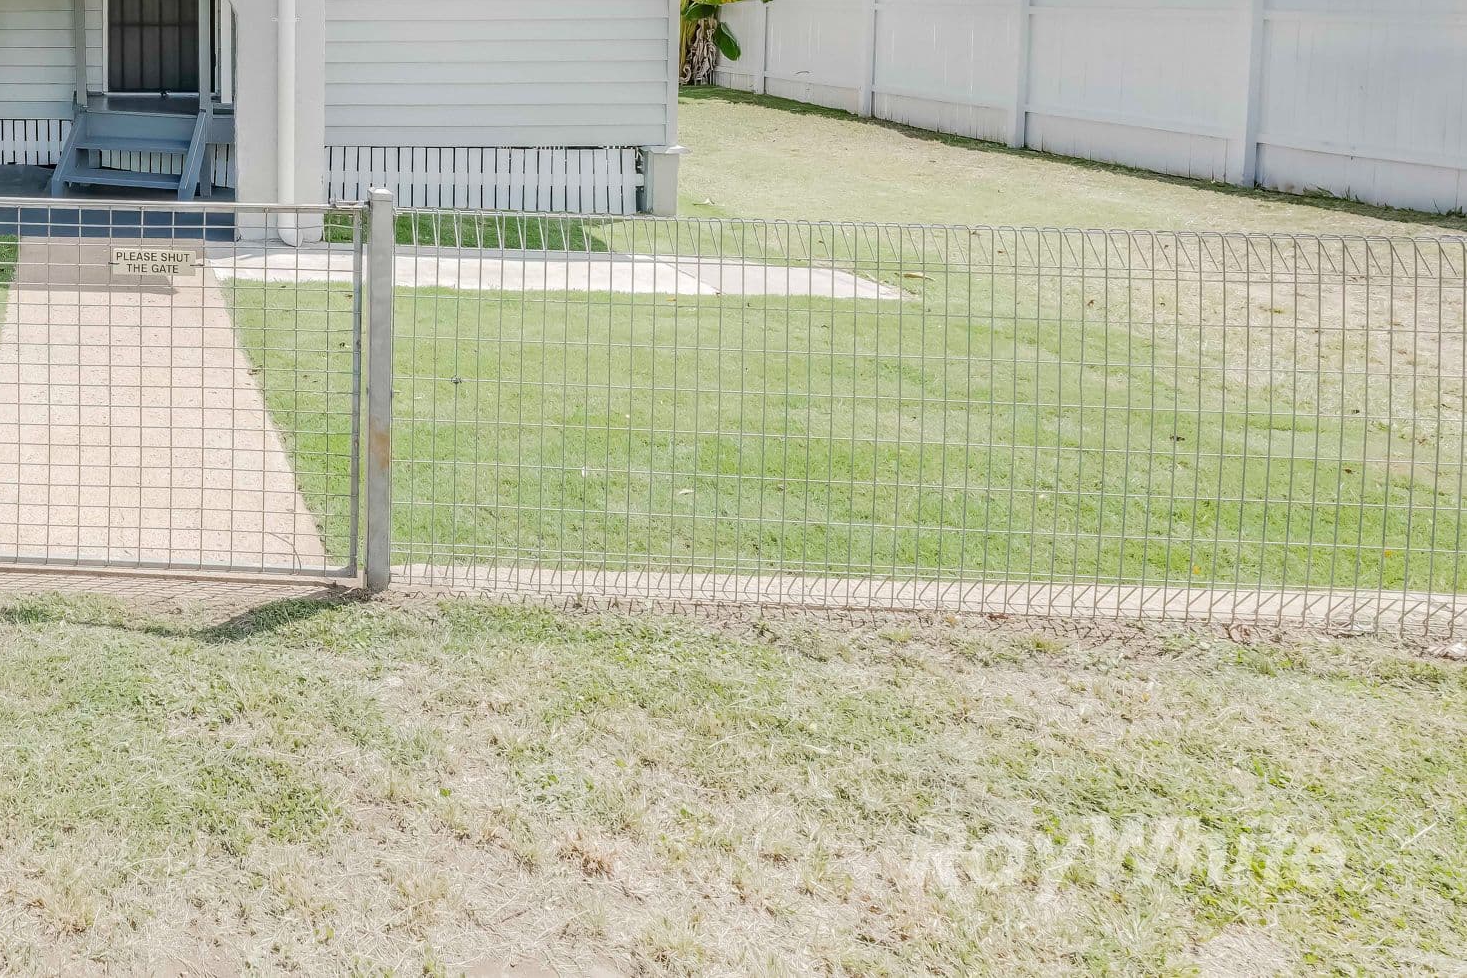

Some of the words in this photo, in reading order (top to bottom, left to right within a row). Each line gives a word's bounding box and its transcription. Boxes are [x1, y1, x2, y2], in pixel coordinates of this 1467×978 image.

[116, 252, 158, 261] PLEASE
[161, 253, 190, 262] SHUT
[126, 263, 148, 273] THE
[151, 264, 179, 274] GATE
